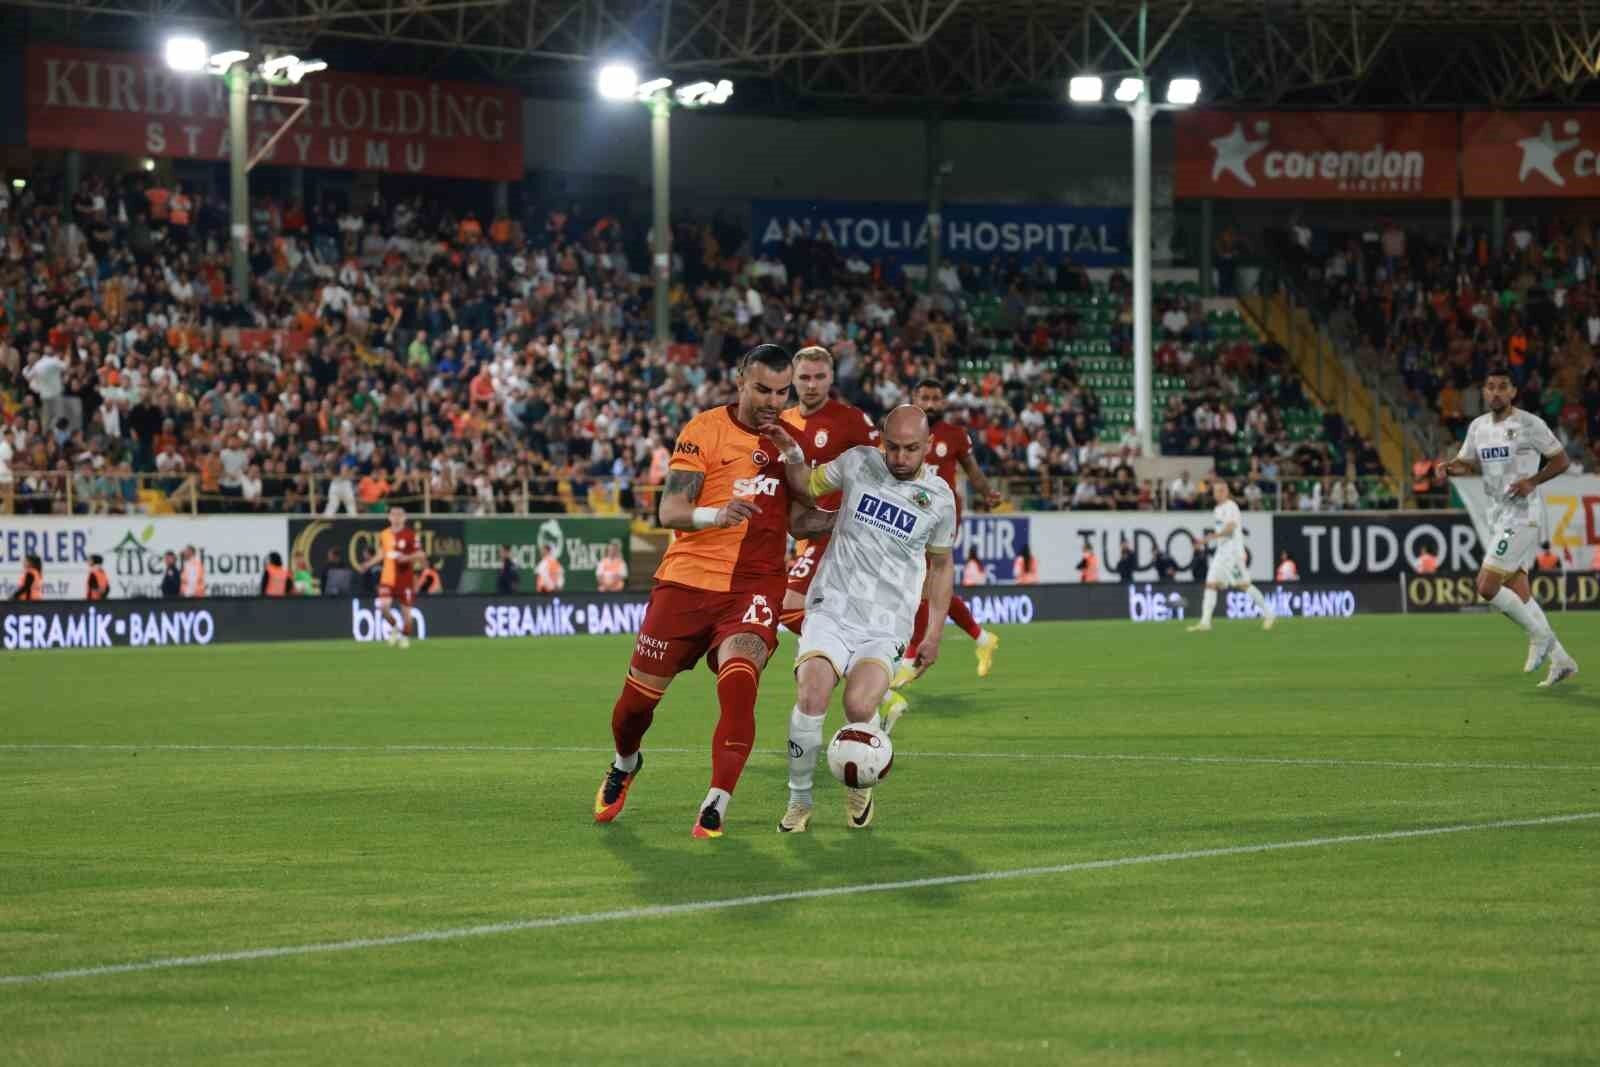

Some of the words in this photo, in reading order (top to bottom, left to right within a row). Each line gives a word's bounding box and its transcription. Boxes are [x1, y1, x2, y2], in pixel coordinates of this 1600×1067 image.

[1264, 143, 1425, 178] corendon
[762, 215, 937, 249] ANATOLIA
[949, 221, 1119, 254] HOSPITAL
[861, 495, 915, 531] TAV
[0, 530, 87, 562] ERLER
[1077, 527, 1252, 573] TUDO
[1495, 539, 1508, 556] 9
[1303, 590, 1355, 617] BANYO
[1409, 577, 1488, 606] ORS
[1531, 576, 1599, 604] OLD
[485, 598, 575, 637] SERAMİK
[589, 602, 650, 634] BANY
[741, 604, 773, 627] 42
[971, 594, 1034, 624] BANYO
[4, 606, 111, 649] SERAMİK
[129, 610, 214, 646] BANYO
